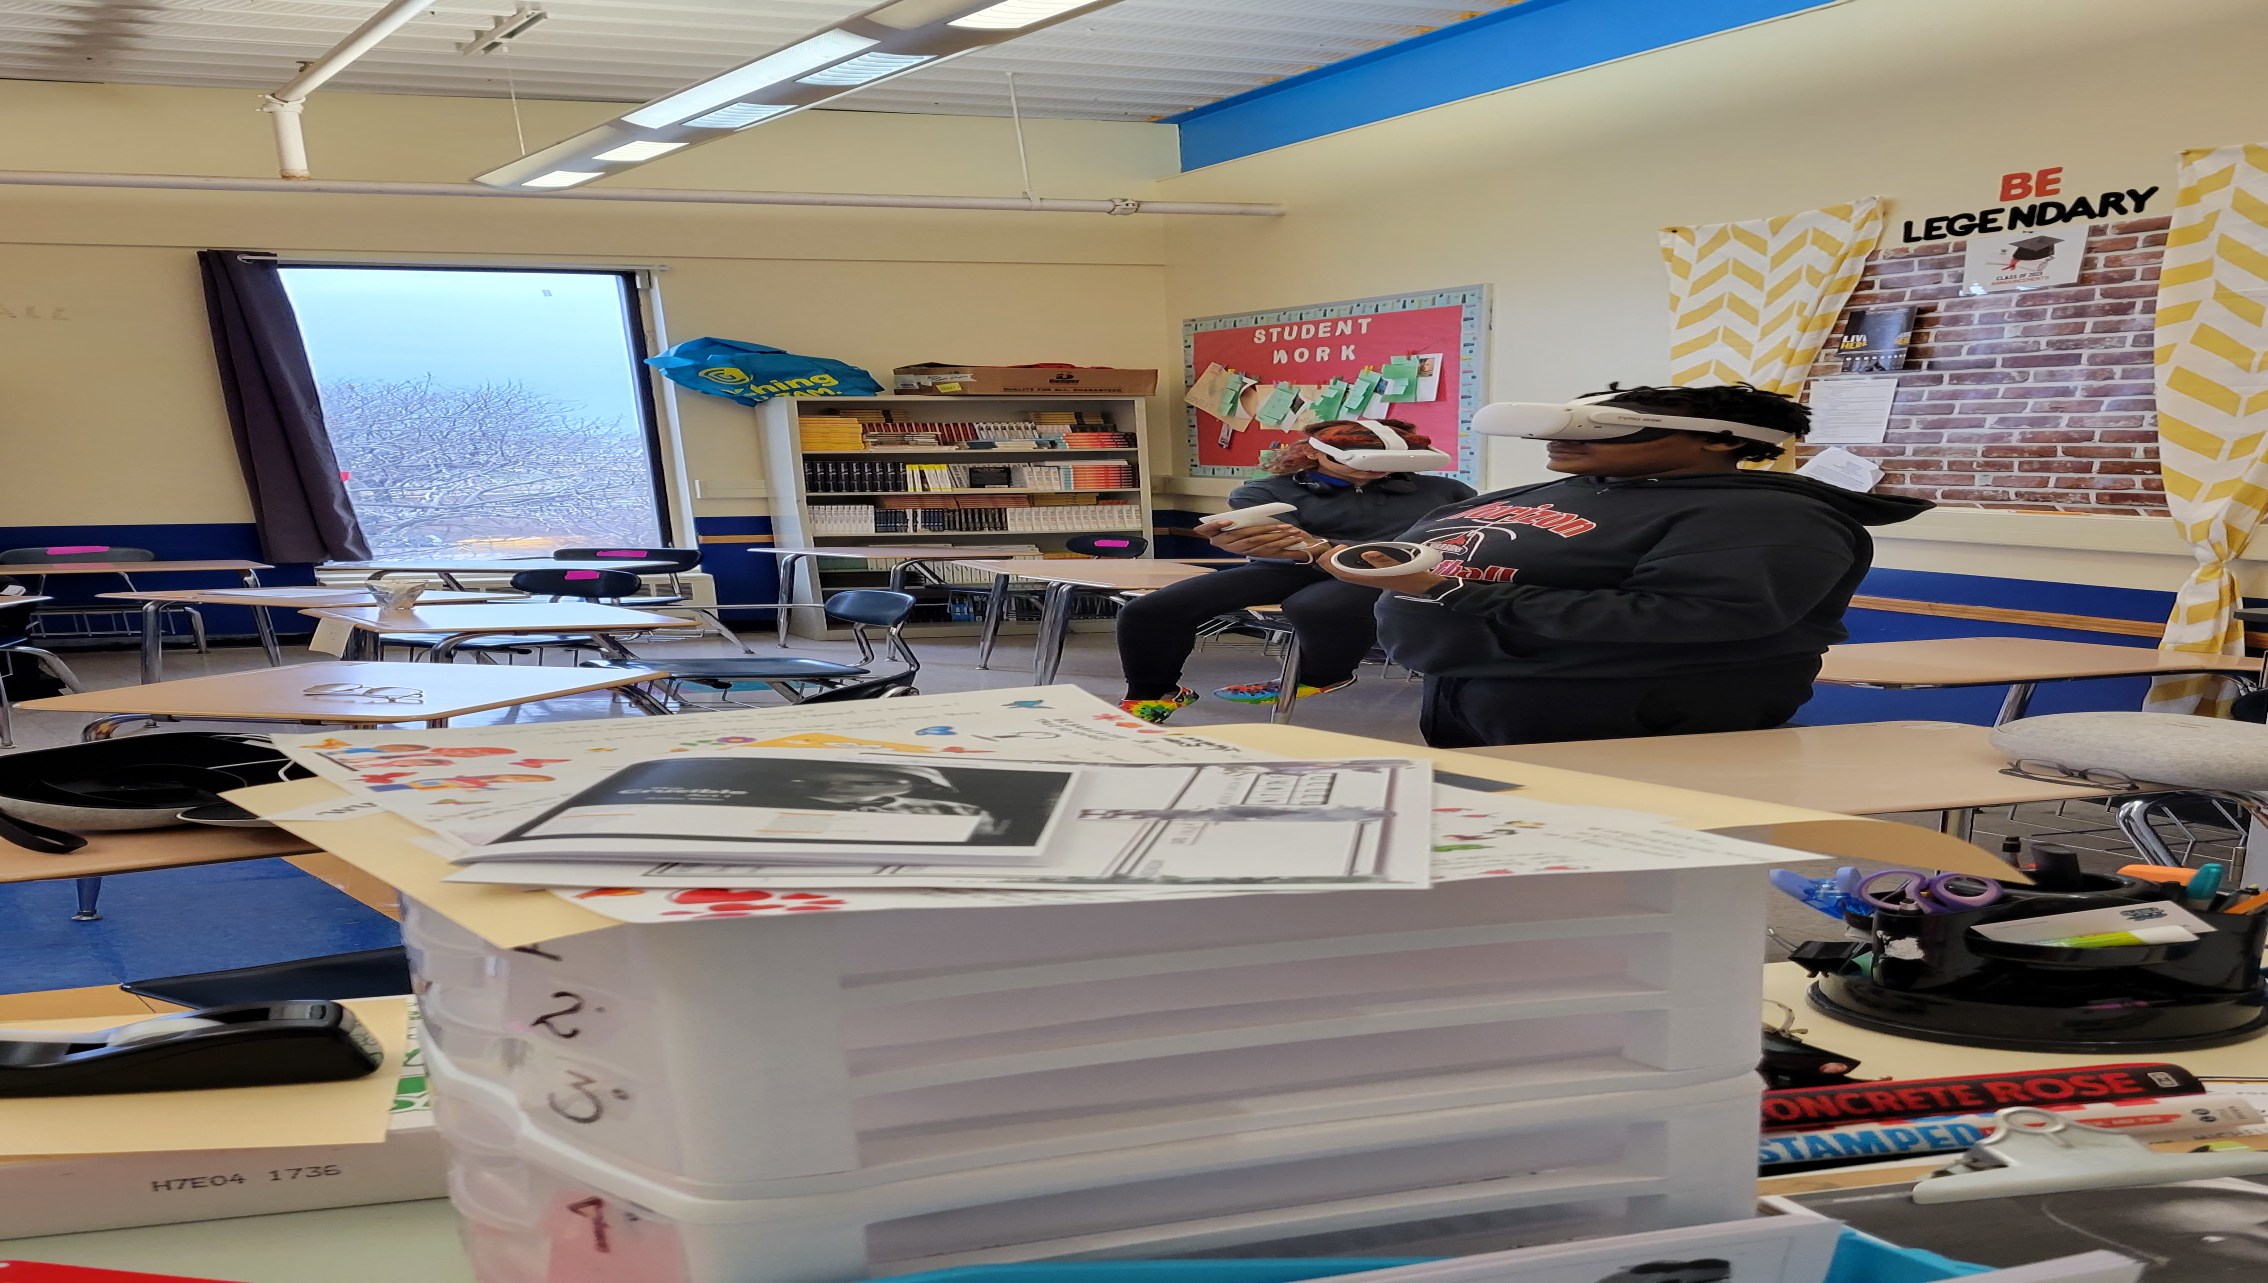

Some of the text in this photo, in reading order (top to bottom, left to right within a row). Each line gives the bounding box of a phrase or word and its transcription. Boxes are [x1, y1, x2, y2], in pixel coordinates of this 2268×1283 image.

[1999, 166, 2064, 202] BE
[1902, 185, 2159, 243] LEGENDARY
[1253, 317, 1373, 344] STUDENT
[1761, 1083, 1975, 1121] ONCRETE
[1989, 1071, 2145, 1106] ROSE
[1759, 1123, 1981, 1164] STAMPED
[268, 1164, 341, 1182] 1736
